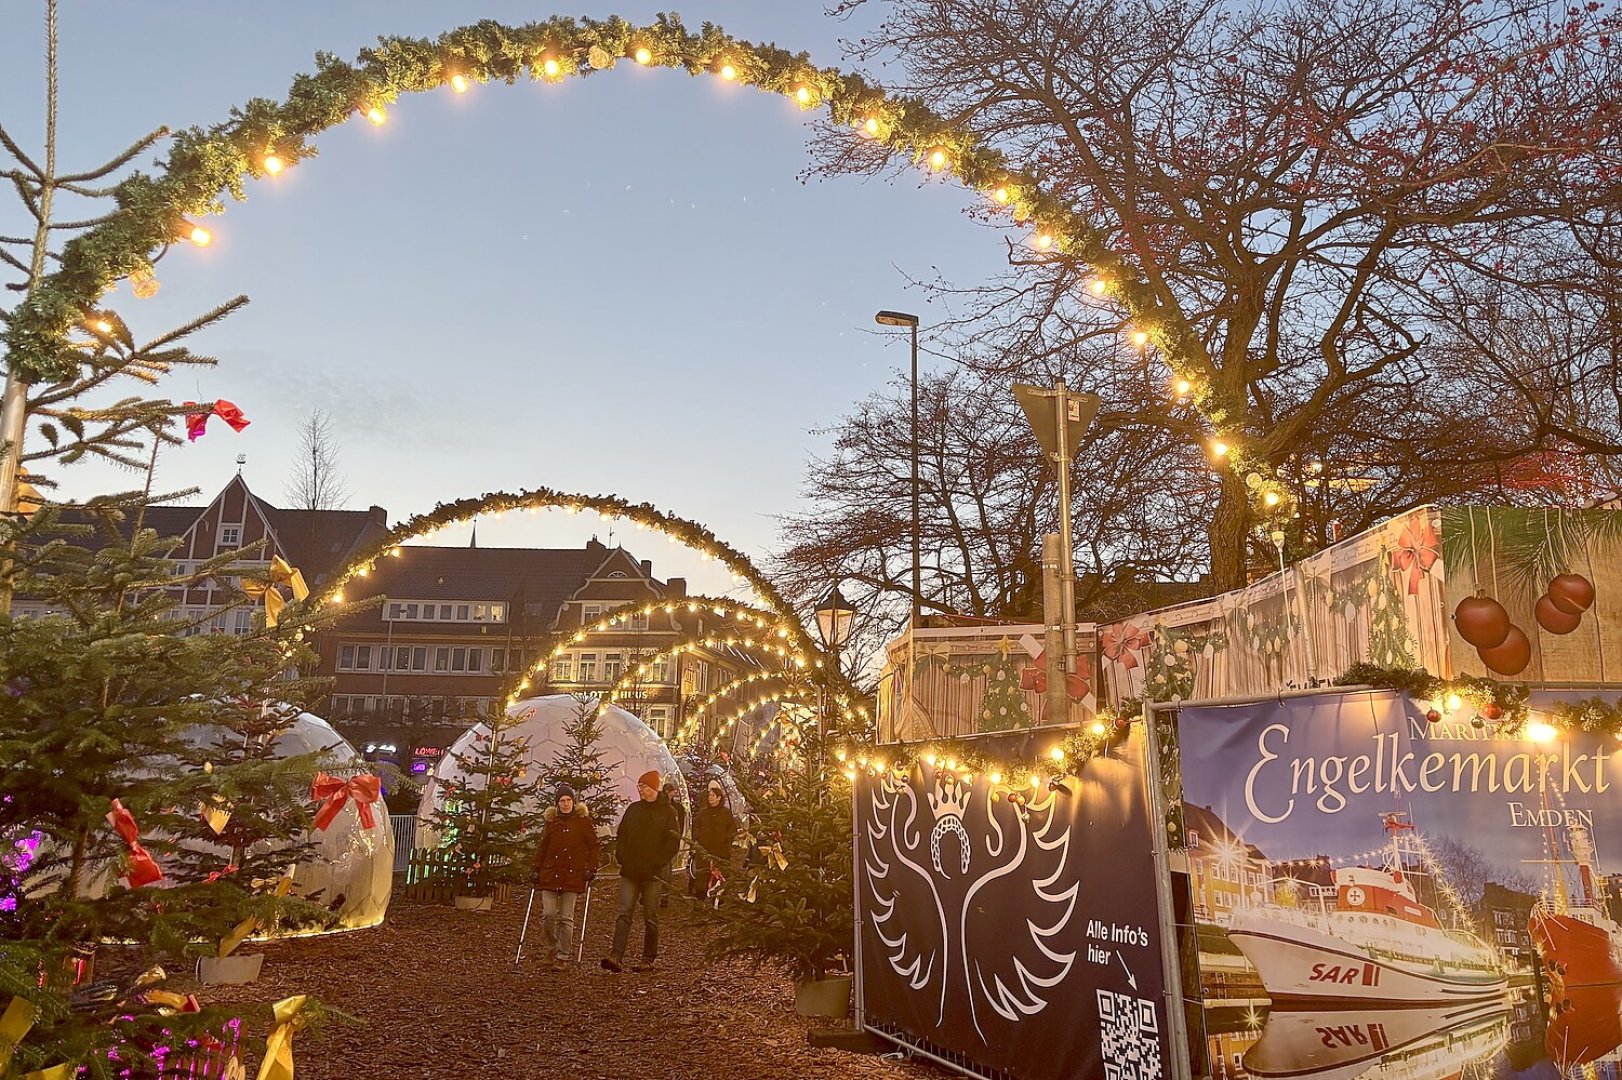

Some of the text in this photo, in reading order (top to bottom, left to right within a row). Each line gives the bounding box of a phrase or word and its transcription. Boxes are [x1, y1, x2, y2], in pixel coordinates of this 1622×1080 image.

[1244, 723, 1611, 824] Engelkemarkt
[1507, 802, 1594, 828] EMDEN
[1086, 919, 1108, 940] Alle
[1087, 943, 1111, 965] hier
[1309, 963, 1359, 985] SAR
